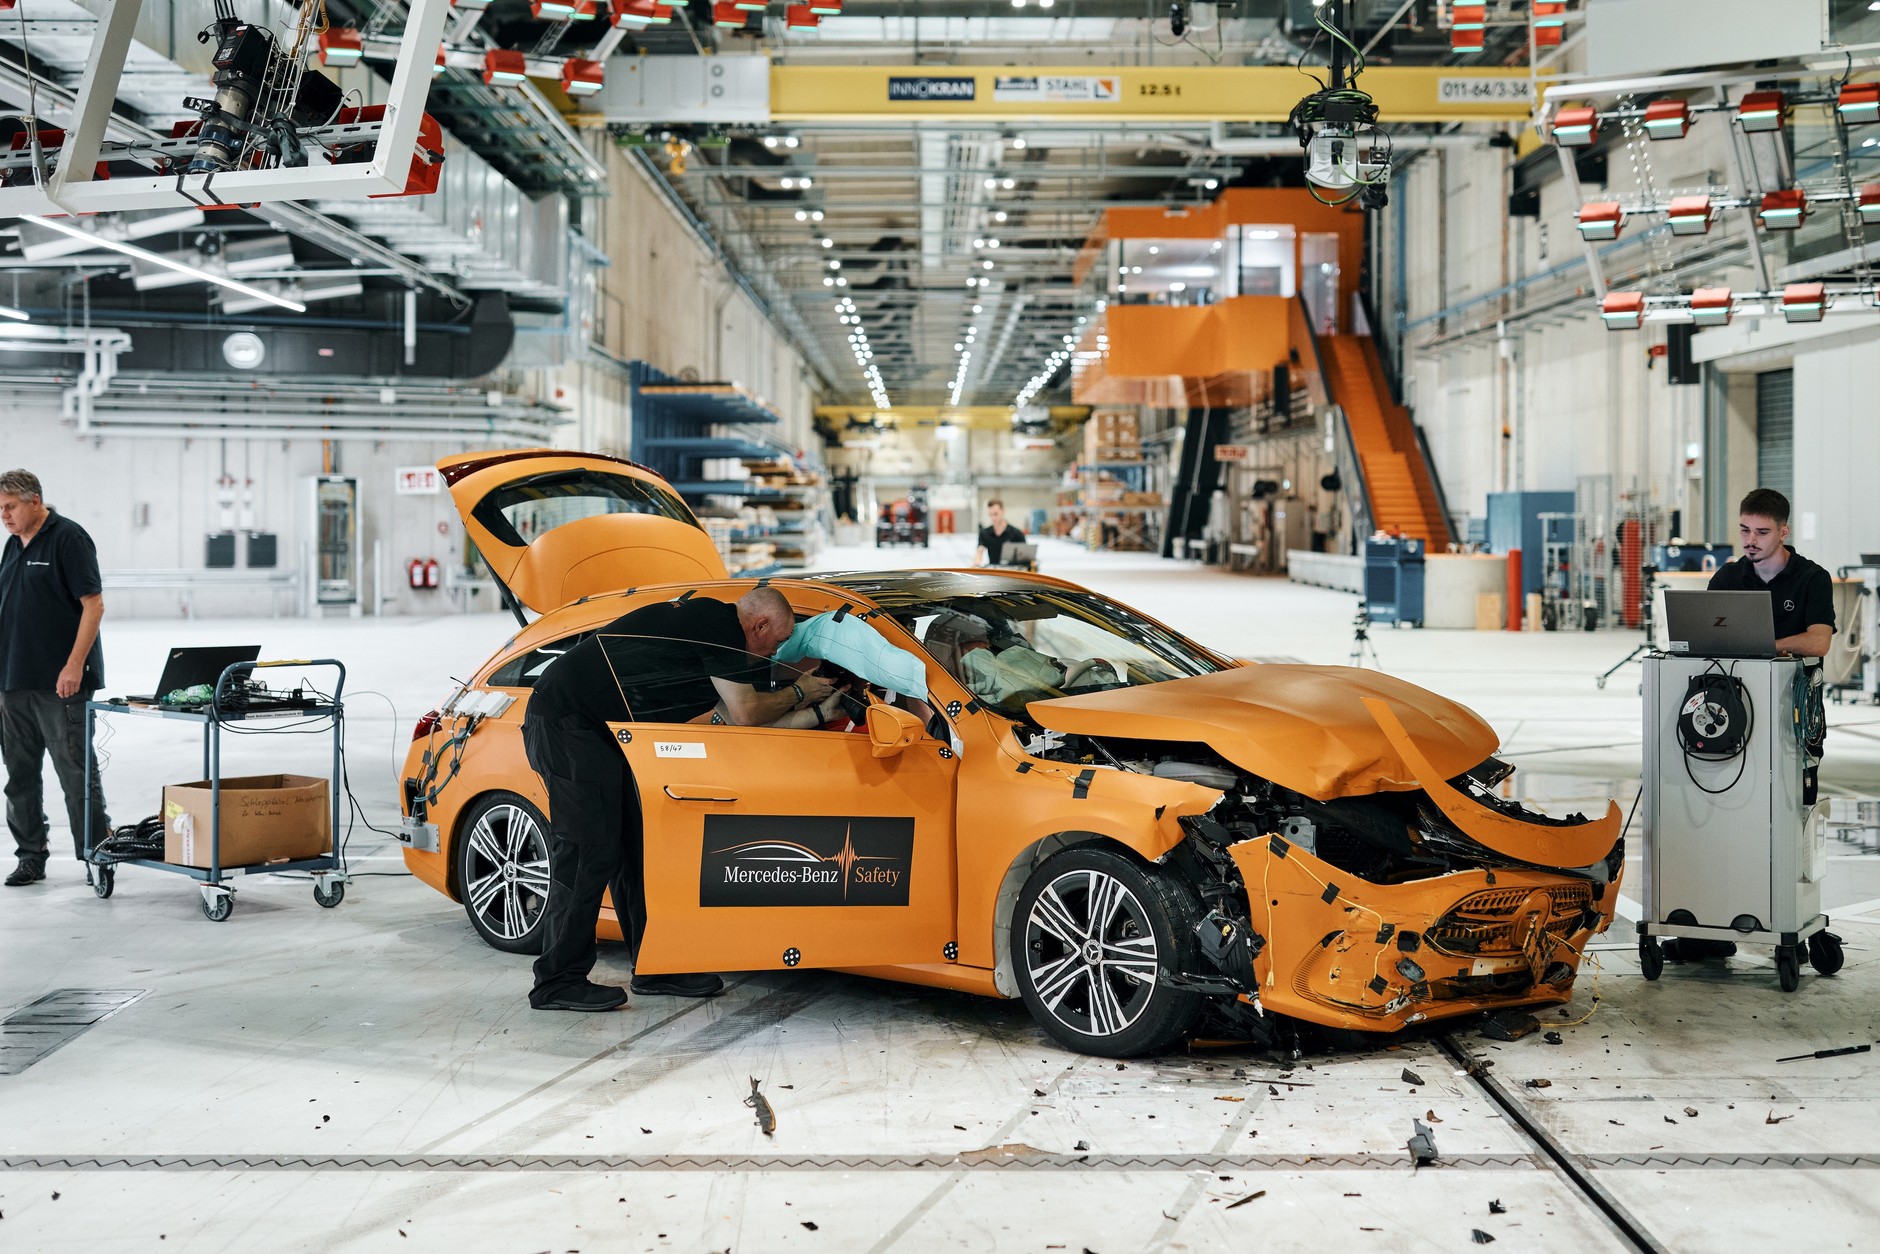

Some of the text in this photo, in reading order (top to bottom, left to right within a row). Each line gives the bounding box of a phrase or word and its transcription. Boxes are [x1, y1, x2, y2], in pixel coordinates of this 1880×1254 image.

[890, 79, 974, 99] INNOKRAN
[1046, 79, 1088, 91] STAHL
[1442, 81, 1528, 98] 011-64/3-34
[660, 744, 682, 752] 58/47
[724, 866, 900, 887] Mercedes-Benz Safety
